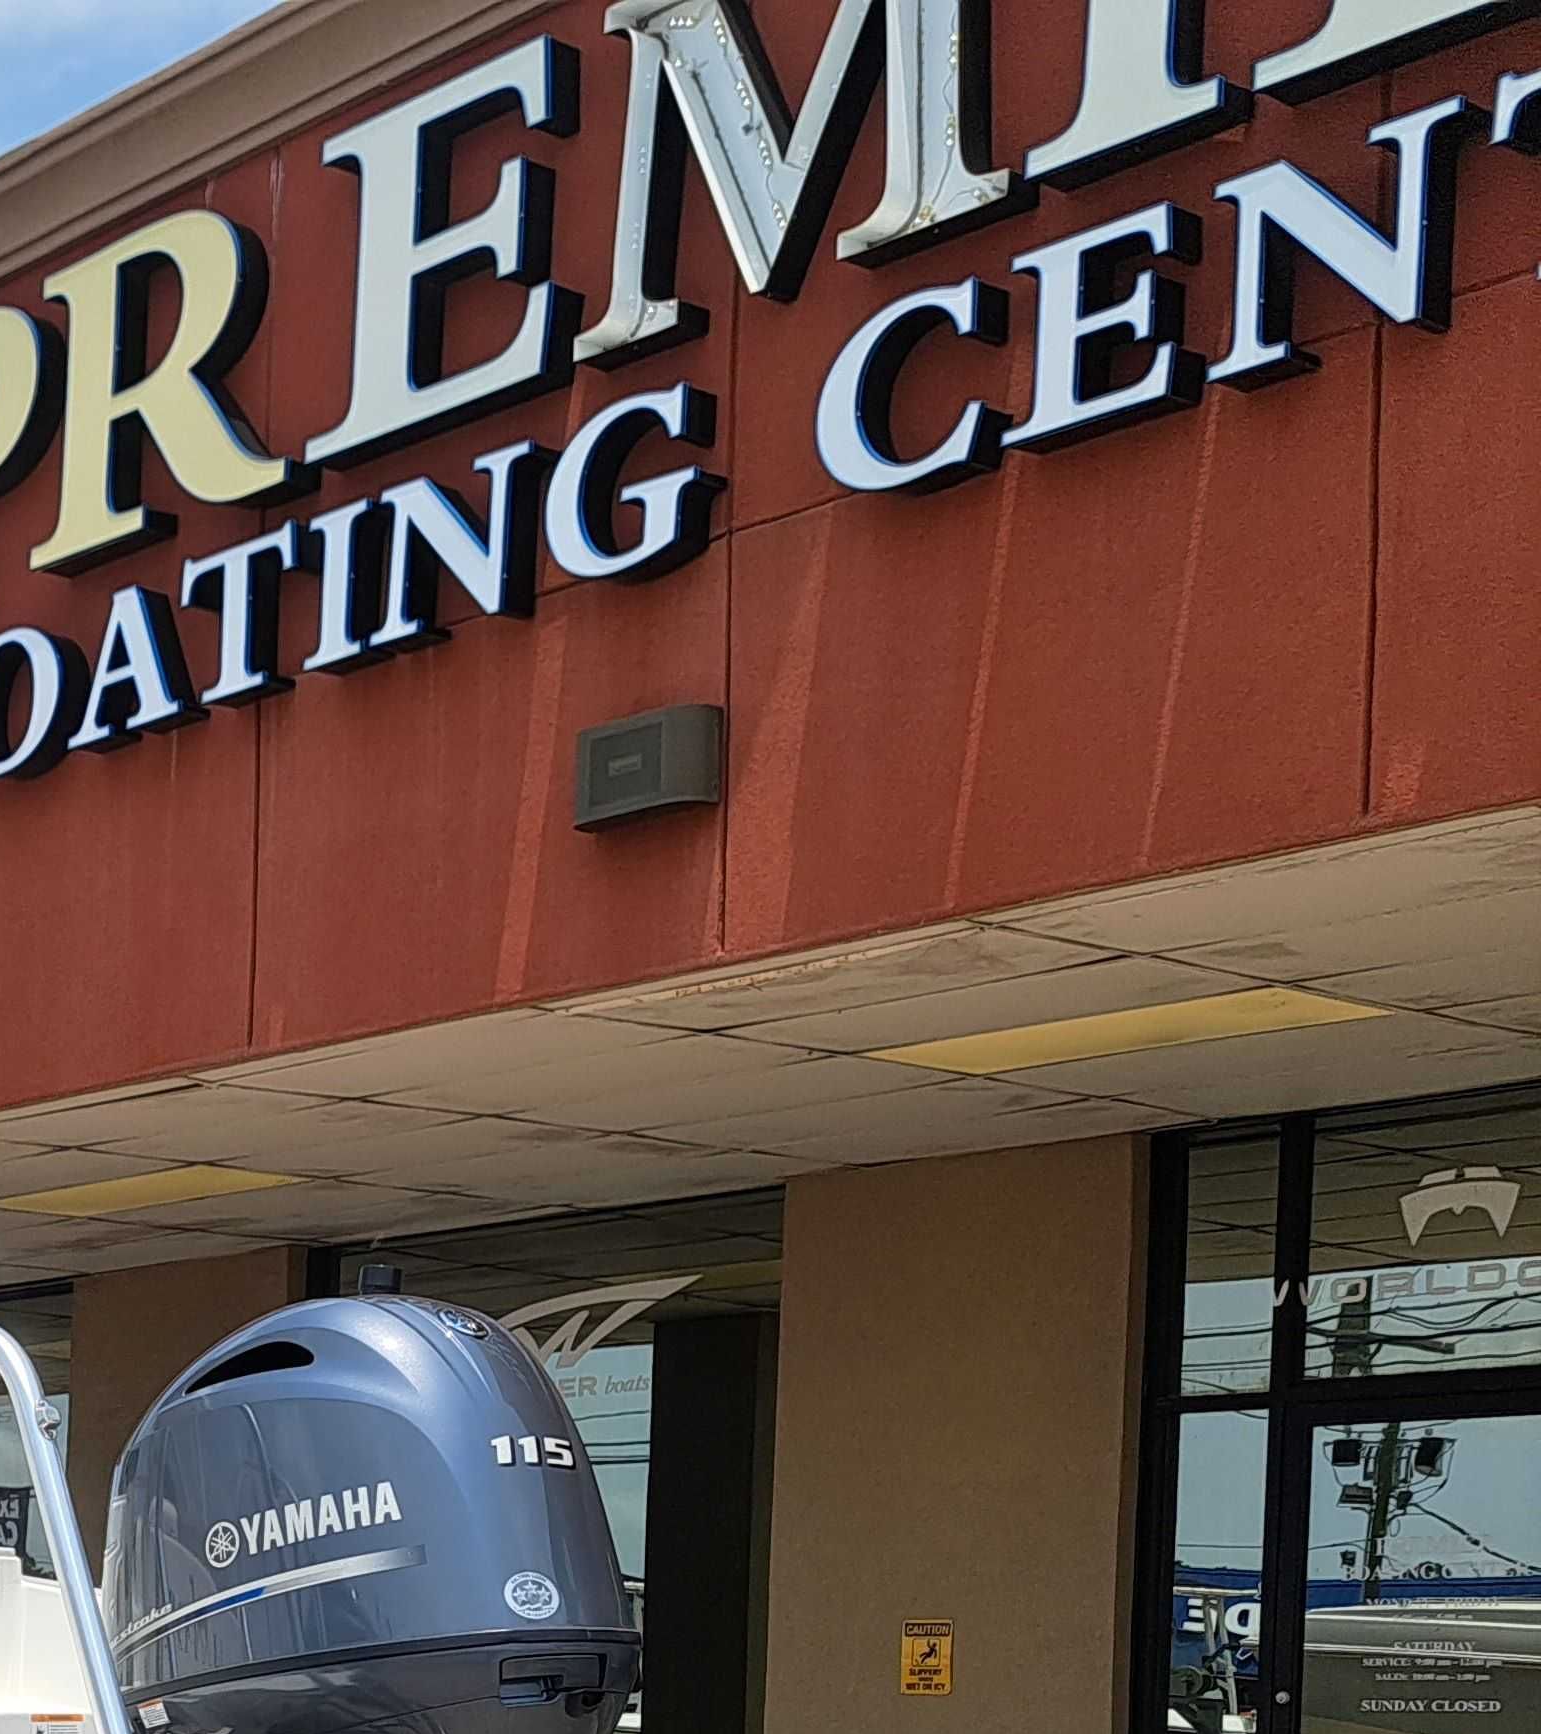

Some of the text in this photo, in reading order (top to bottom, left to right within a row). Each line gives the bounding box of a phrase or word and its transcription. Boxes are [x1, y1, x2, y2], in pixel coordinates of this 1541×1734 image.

[815, 70, 1541, 490] CEN
[604, 1375, 650, 1395] boats
[490, 1434, 577, 1470] 115
[239, 1481, 403, 1556] YAMAHA
[906, 1624, 950, 1635] CAUTION
[1393, 1640, 1476, 1652] SATURDAY
[1360, 1699, 1502, 1713] SUNDAY CLOSED
